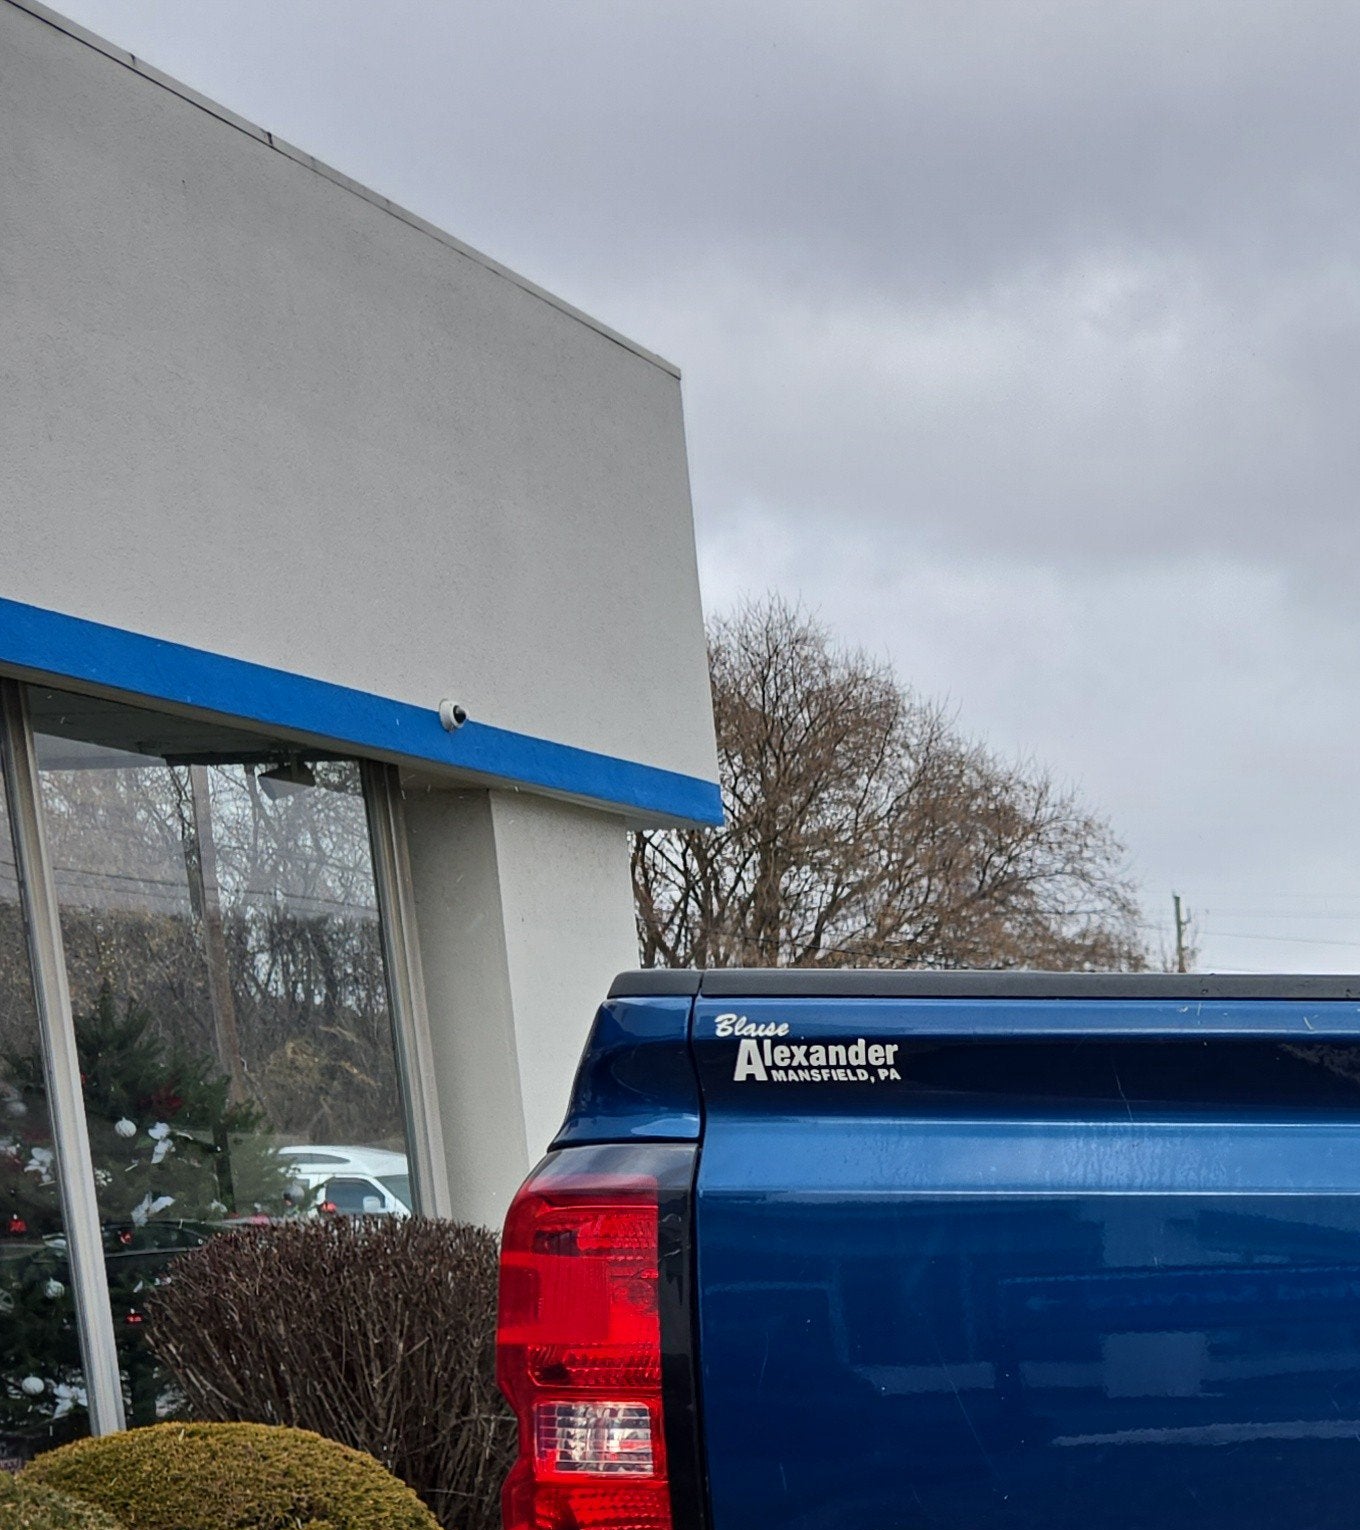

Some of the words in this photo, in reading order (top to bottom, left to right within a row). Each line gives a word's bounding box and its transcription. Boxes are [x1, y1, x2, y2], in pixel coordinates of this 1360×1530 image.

[714, 1013, 790, 1038] Blaise
[733, 1037, 899, 1082] Alexander
[771, 1068, 875, 1084] MANSFIELD,
[878, 1068, 902, 1081] PA
